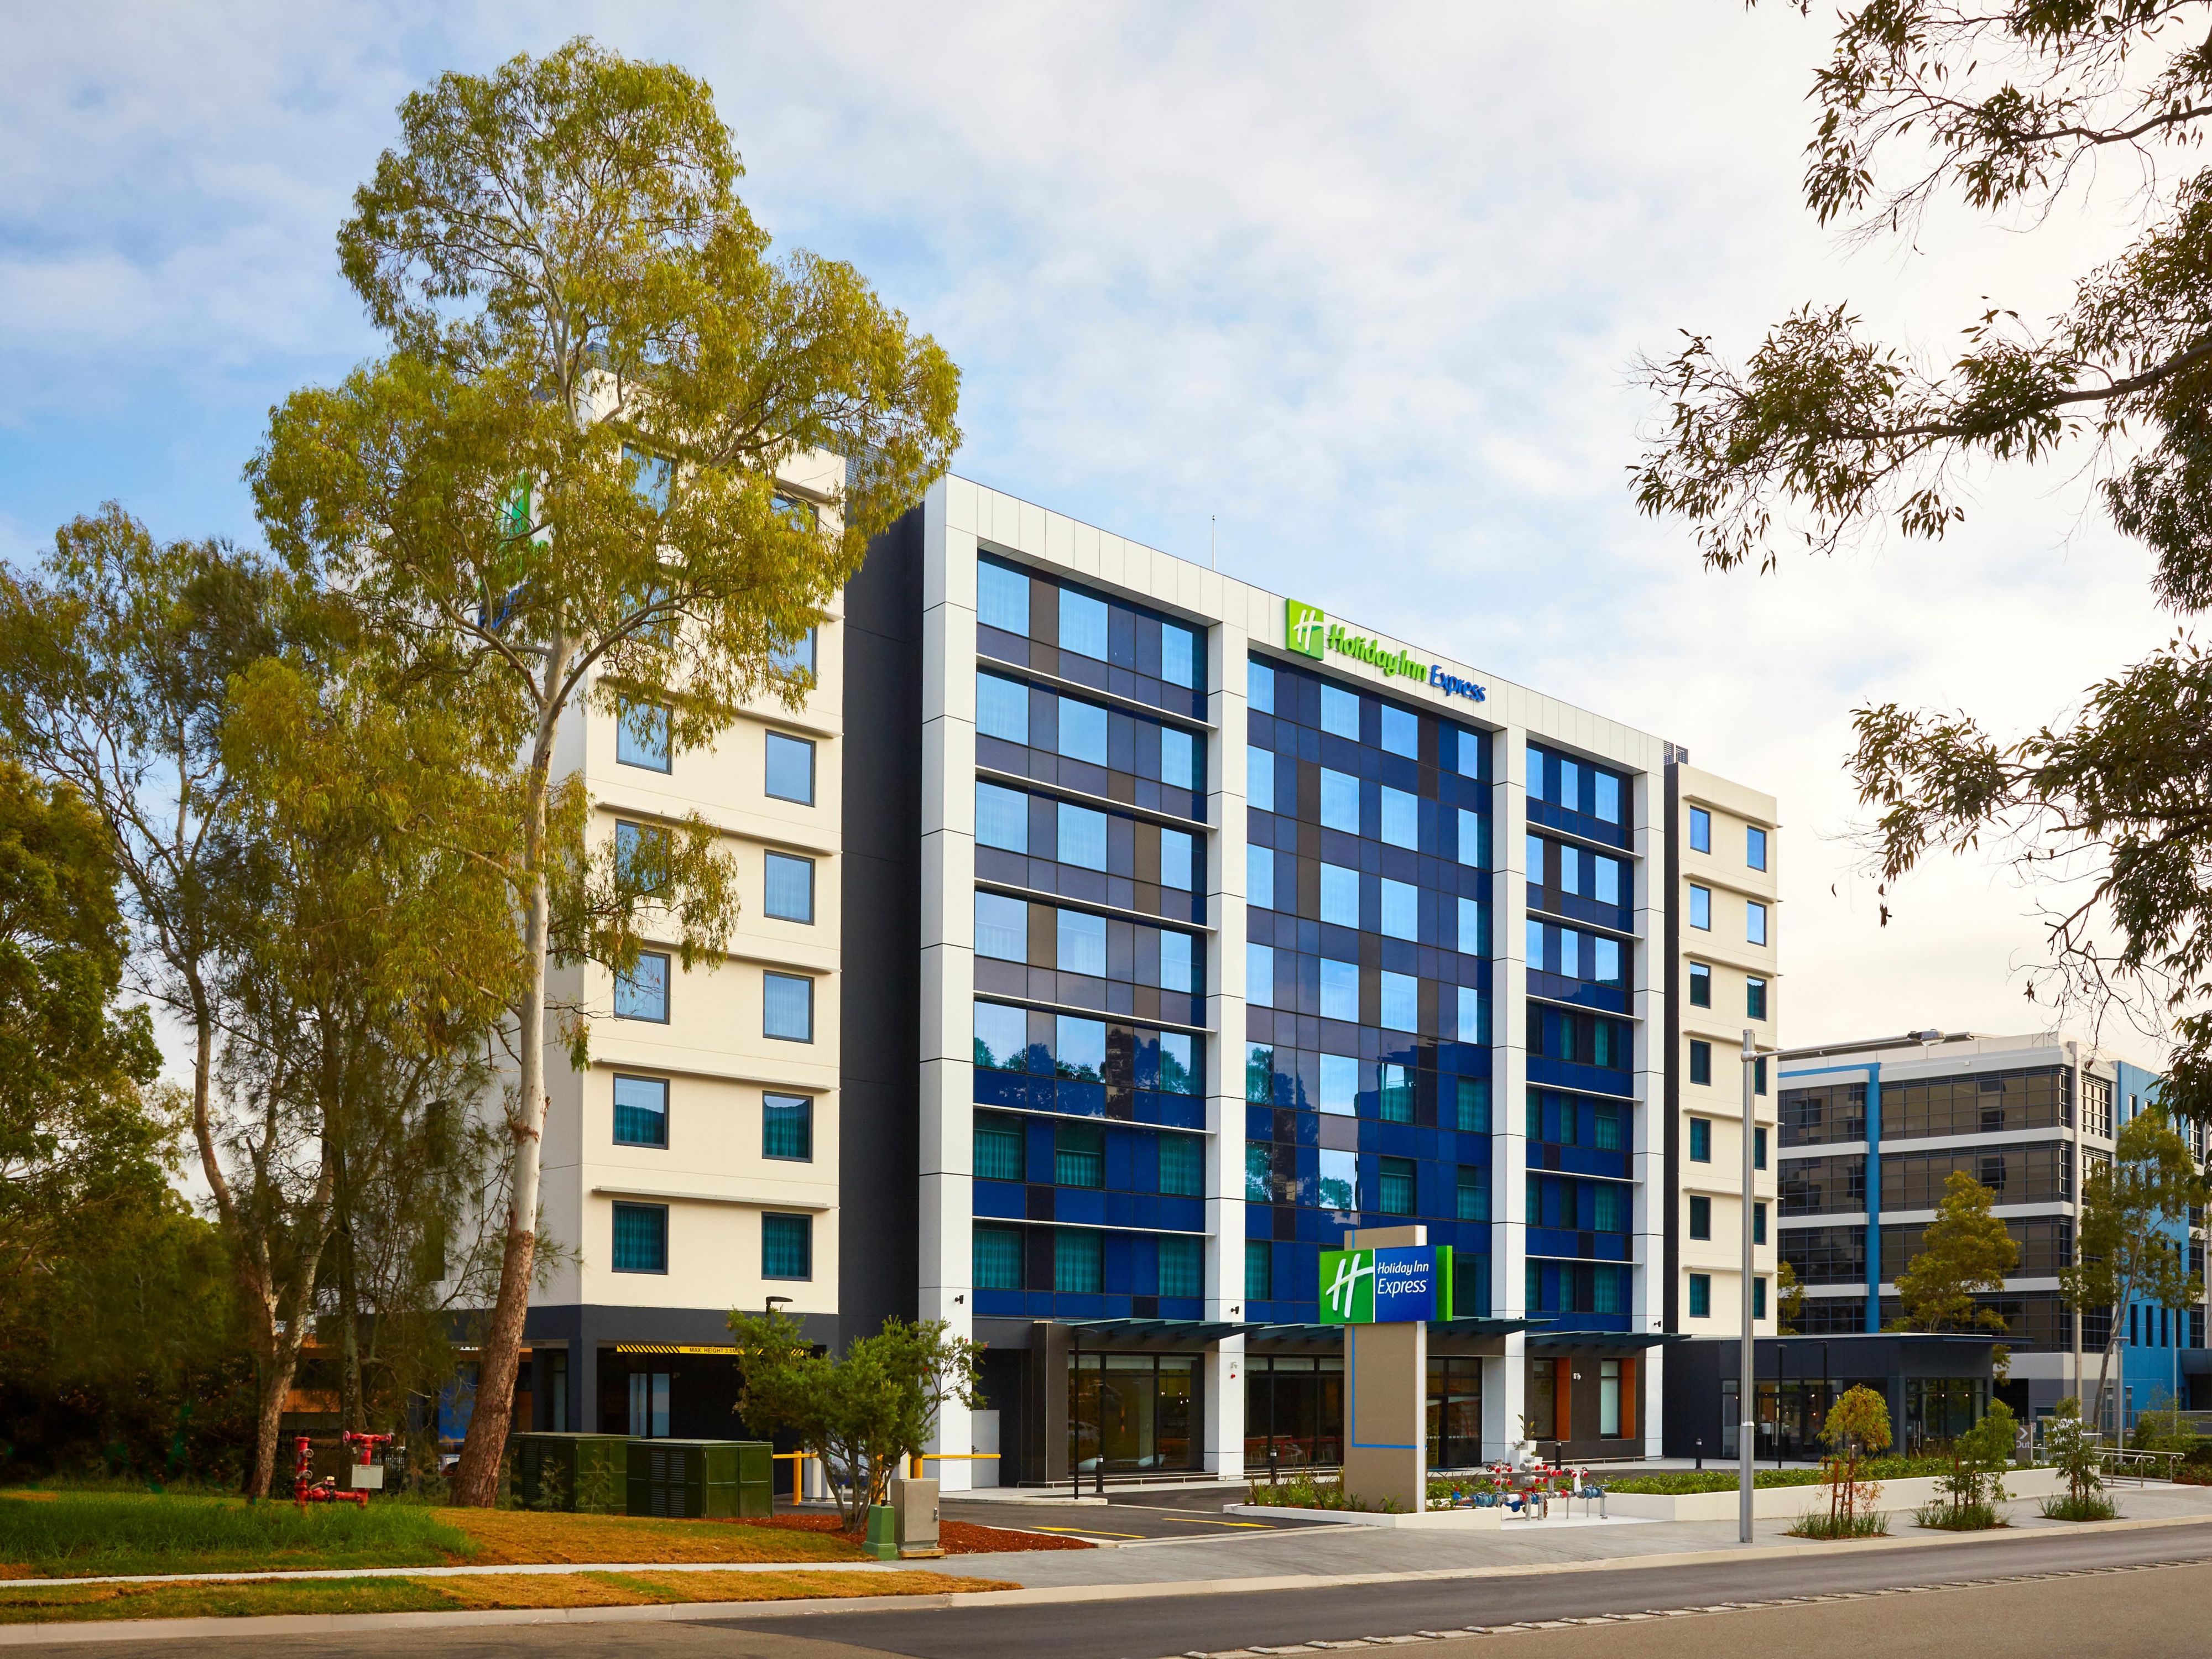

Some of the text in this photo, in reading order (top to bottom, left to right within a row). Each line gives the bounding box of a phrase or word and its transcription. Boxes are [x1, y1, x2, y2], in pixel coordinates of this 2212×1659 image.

[1328, 624, 1486, 702] Holiday Inn Express
[1377, 1260, 1429, 1275] Holiday Inn
[1377, 1278, 1427, 1298] Express
[2016, 1440, 2031, 1448] Out
